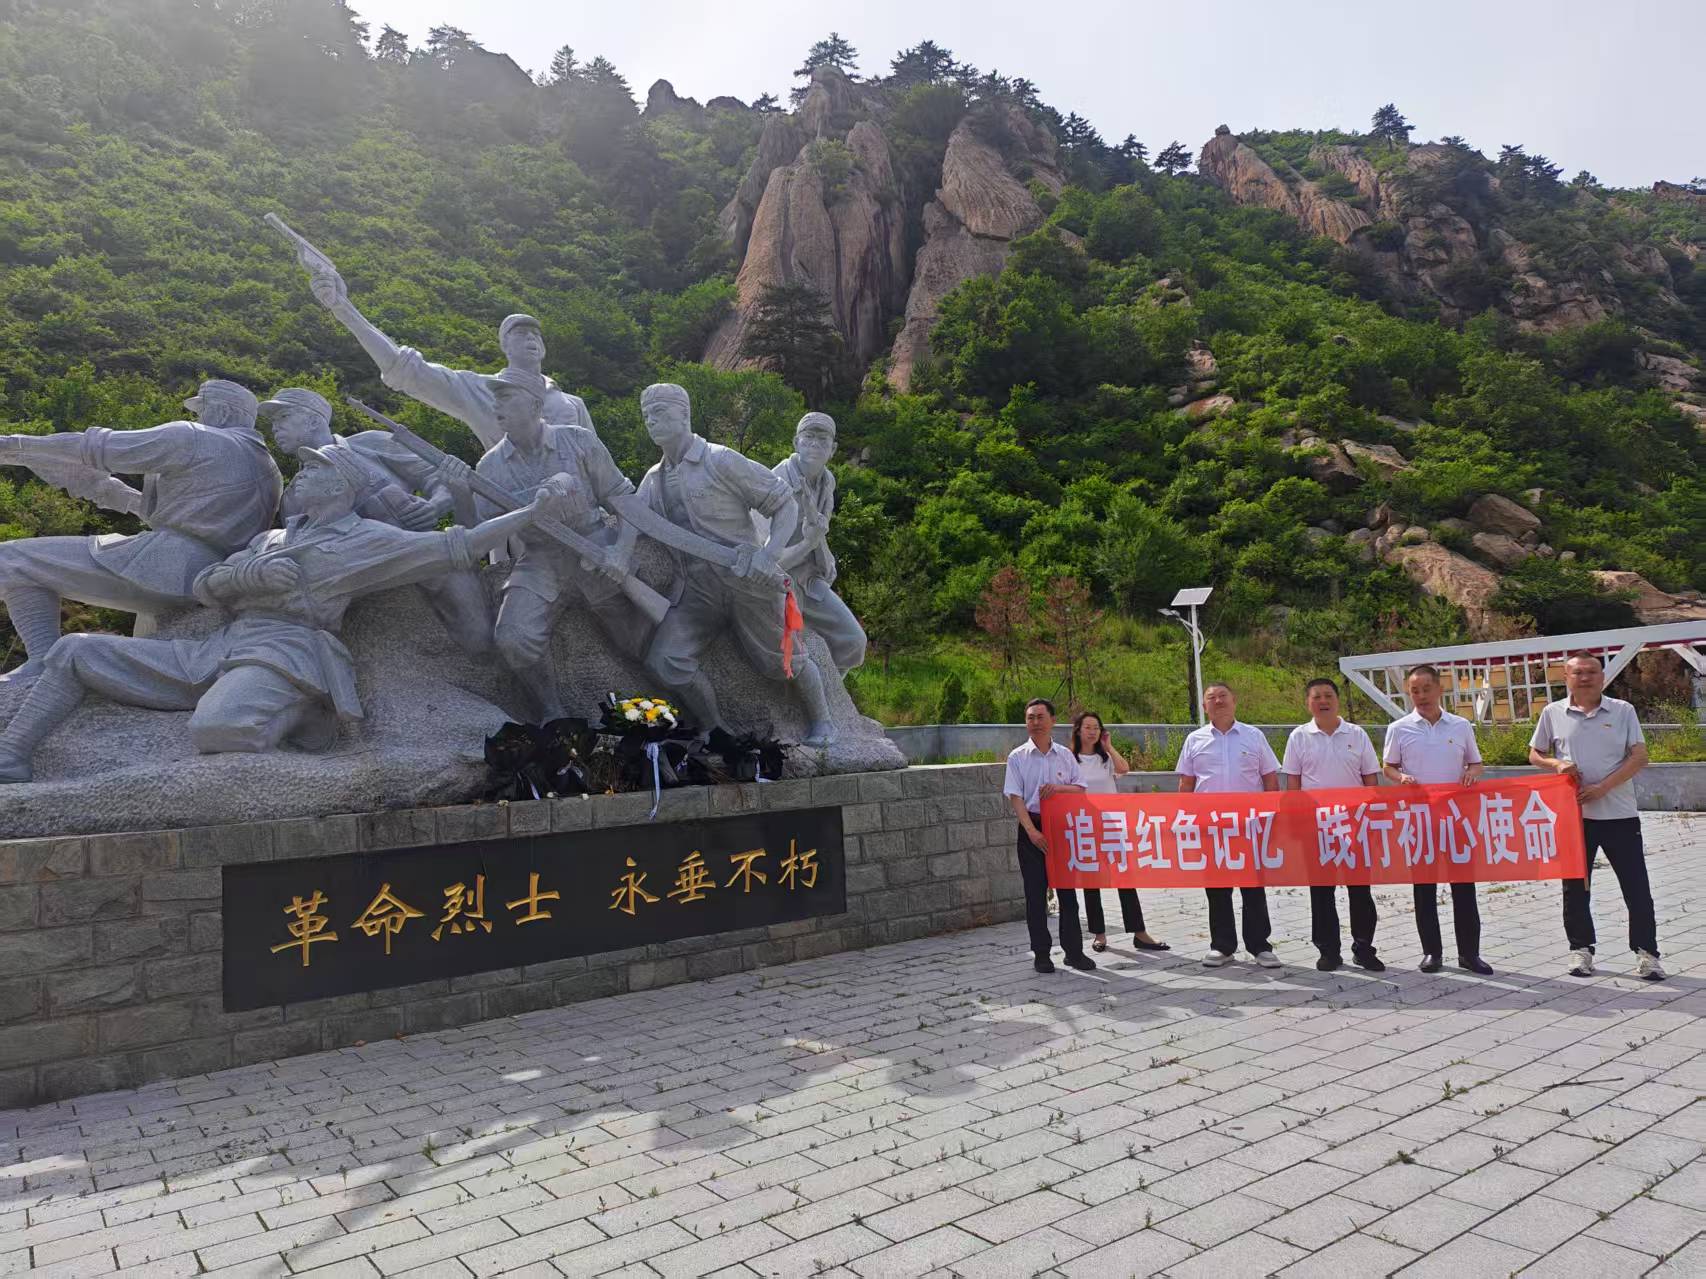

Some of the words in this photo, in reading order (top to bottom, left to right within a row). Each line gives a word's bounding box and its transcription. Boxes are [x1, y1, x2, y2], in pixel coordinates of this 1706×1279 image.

[1064, 808, 1284, 873] 追寻红色记忆
[1316, 791, 1558, 867] 践行初心使命
[270, 873, 561, 967] 革命烈士
[608, 839, 818, 915] 永垂不朽
